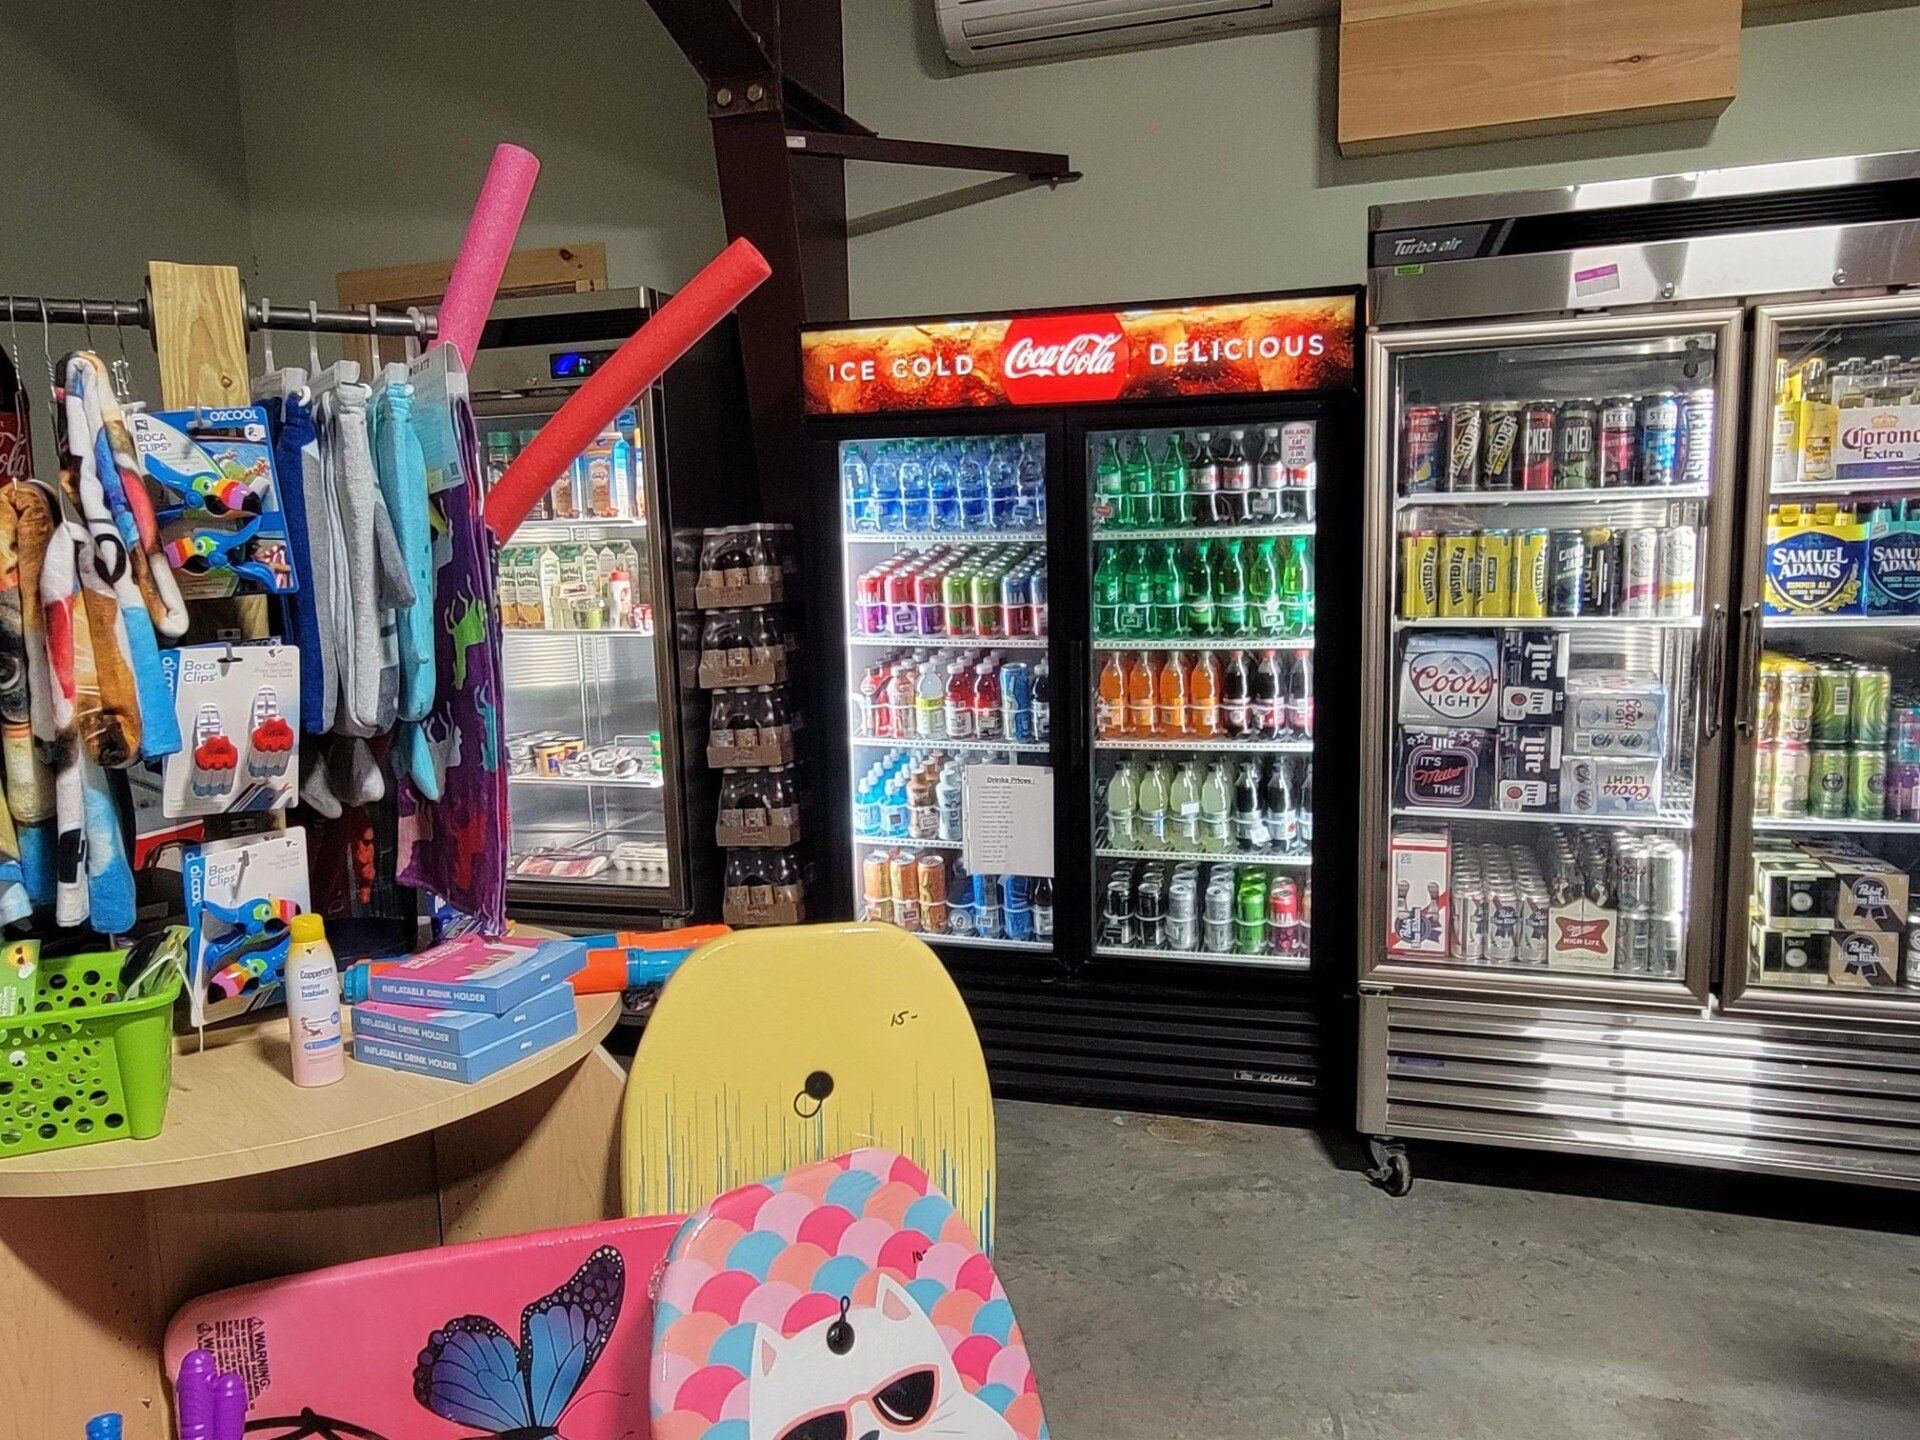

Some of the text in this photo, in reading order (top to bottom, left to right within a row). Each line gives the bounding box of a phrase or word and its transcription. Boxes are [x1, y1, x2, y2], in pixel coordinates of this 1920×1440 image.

[1394, 237, 1463, 256] Turbo air
[828, 332, 1325, 383] ICE COLD Coca-Cola DELICIOUS
[136, 432, 168, 443] BOCA
[1450, 414, 1482, 477] HARDER
[1863, 447, 1904, 460] Extra
[1772, 546, 1849, 566] SAMUEL
[1778, 562, 1841, 580] ADAMS
[184, 660, 216, 671] Boca
[1525, 641, 1553, 682] Lite
[183, 671, 216, 685] Clips
[1412, 665, 1497, 695] Coors
[1428, 694, 1482, 708] LIGHT
[1530, 691, 1545, 713] Lite
[1431, 737, 1456, 751] Lite
[1420, 756, 1442, 767] IT'S
[1519, 736, 1546, 774] Lite
[1412, 766, 1465, 787] Miller
[1607, 775, 1645, 784] LIGHT
[1433, 784, 1461, 795] TIME
[1525, 783, 1539, 804] Lite
[208, 863, 236, 877] Boca
[208, 874, 237, 888] Clips
[1858, 883, 1883, 895] Pabst
[1563, 937, 1600, 947] HIGH LIFE
[1848, 940, 1874, 953] Pabst
[381, 984, 424, 997] INFLATABLE
[426, 988, 452, 1000] DRINK
[453, 991, 486, 1003] HOLDER
[359, 1016, 396, 1032] INFLATABLE
[397, 1023, 420, 1037] DRINK
[421, 1029, 450, 1043] HOLDER
[363, 1045, 402, 1060] INFLATABLE
[404, 1052, 427, 1065] DRINK
[428, 1057, 458, 1072] HOLDER
[254, 1331, 271, 1391] WARNING:
